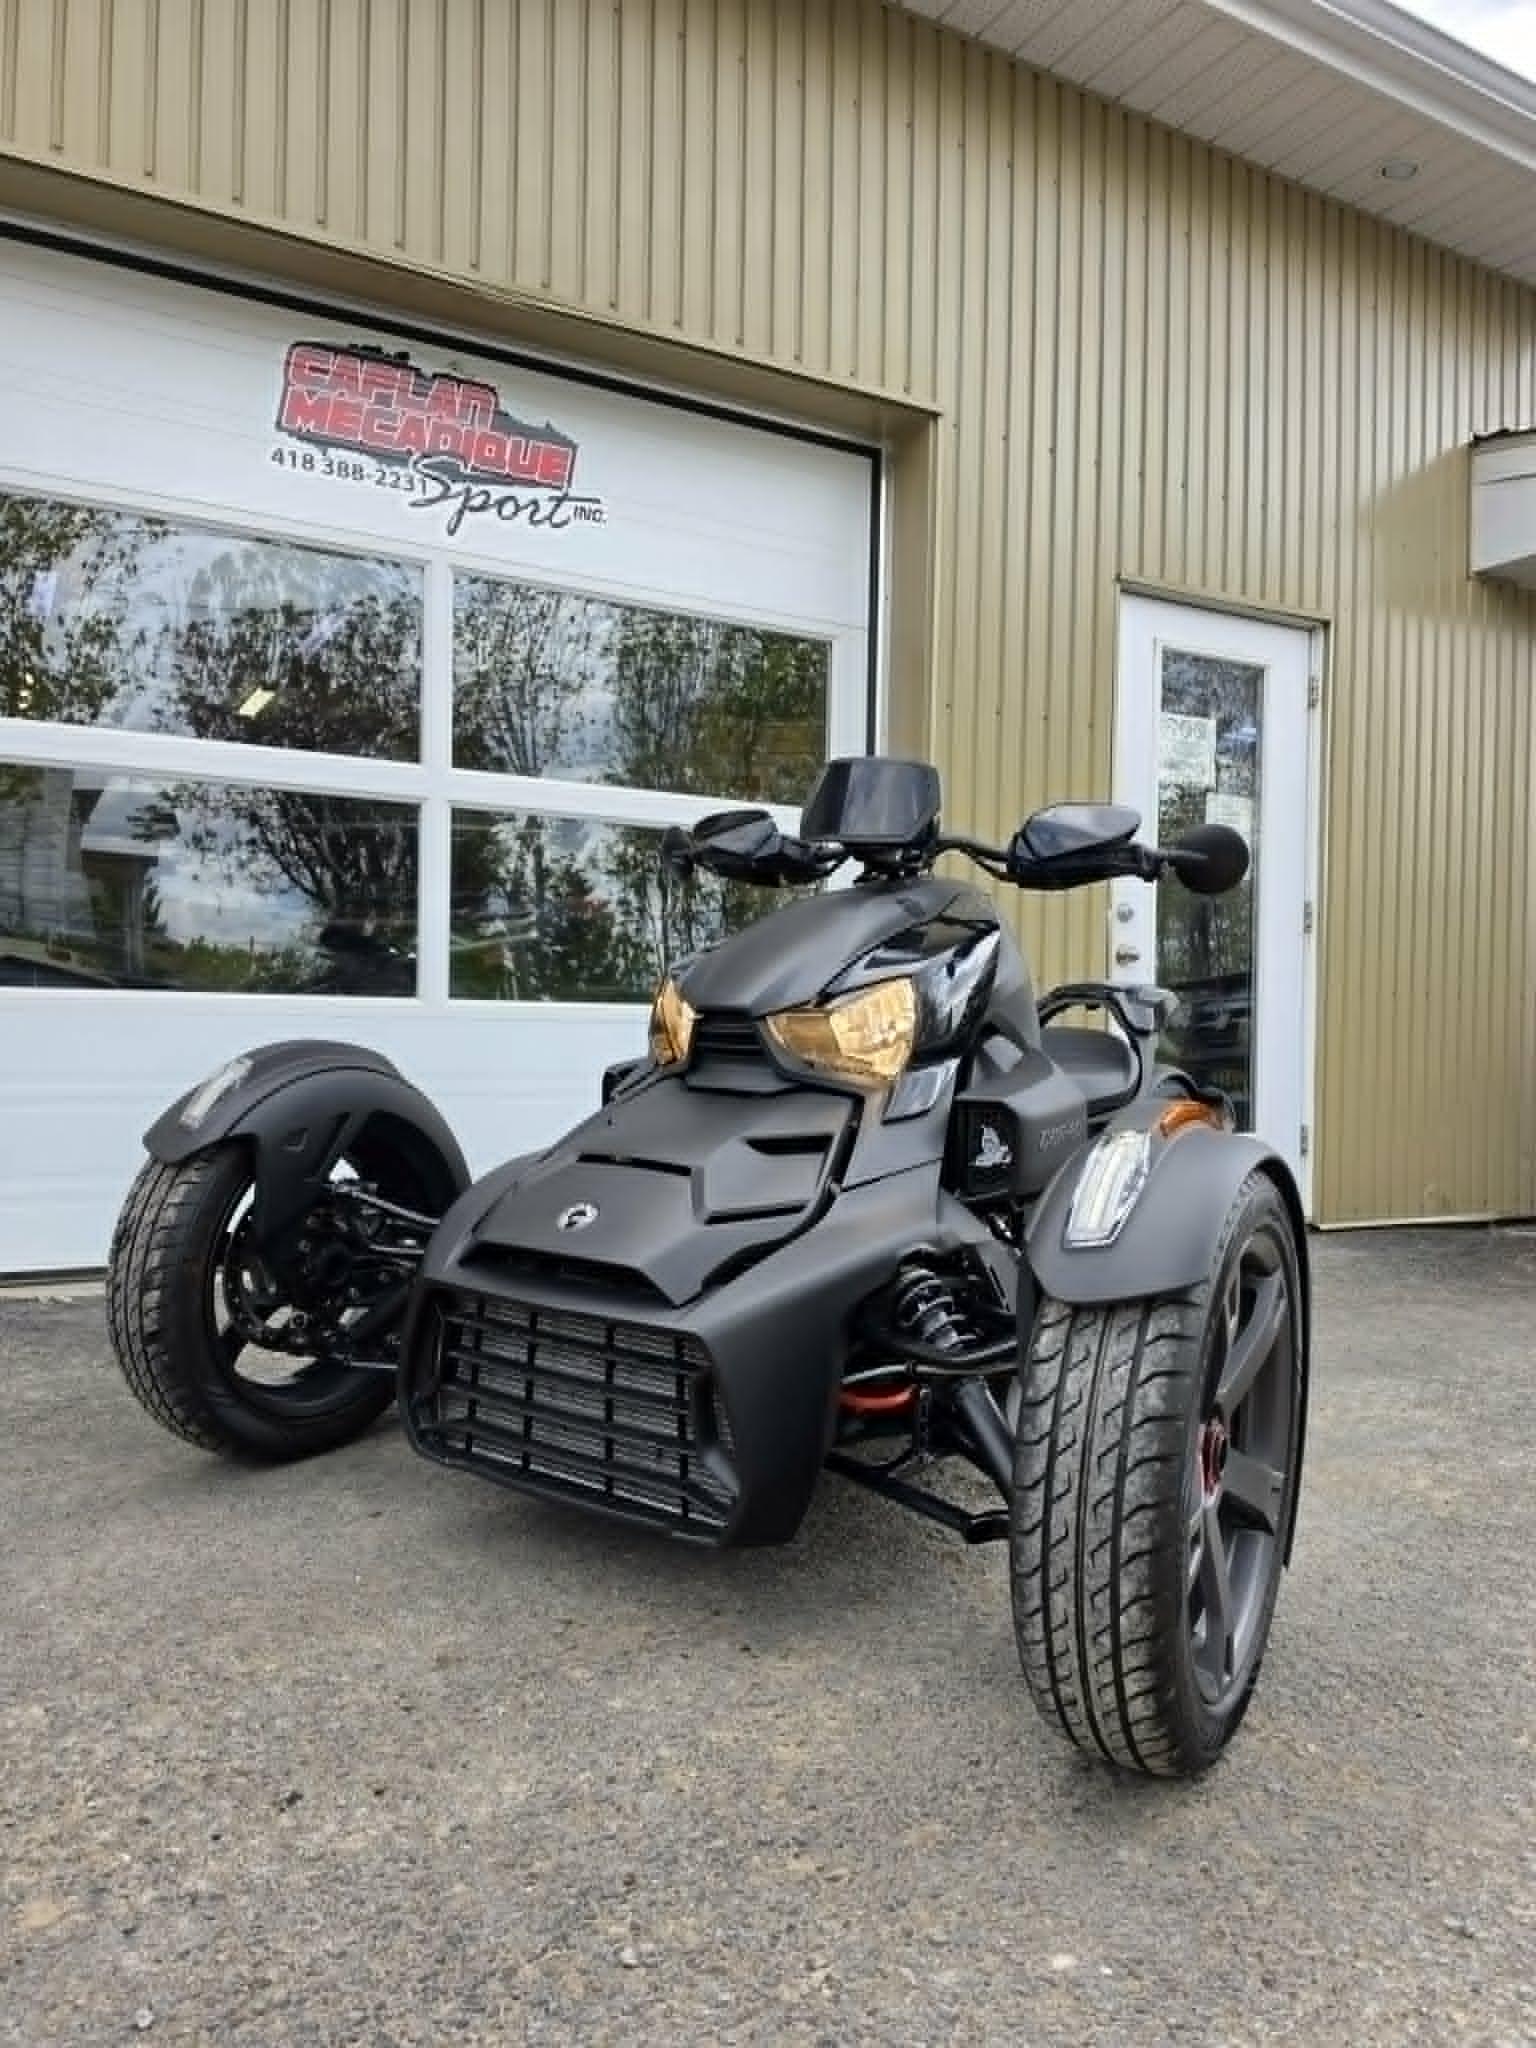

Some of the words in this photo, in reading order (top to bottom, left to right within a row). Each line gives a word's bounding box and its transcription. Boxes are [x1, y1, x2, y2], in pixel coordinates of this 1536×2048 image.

[271, 448, 315, 471] 418
[322, 455, 428, 496] 388-2231
[408, 452, 601, 537] Sport
